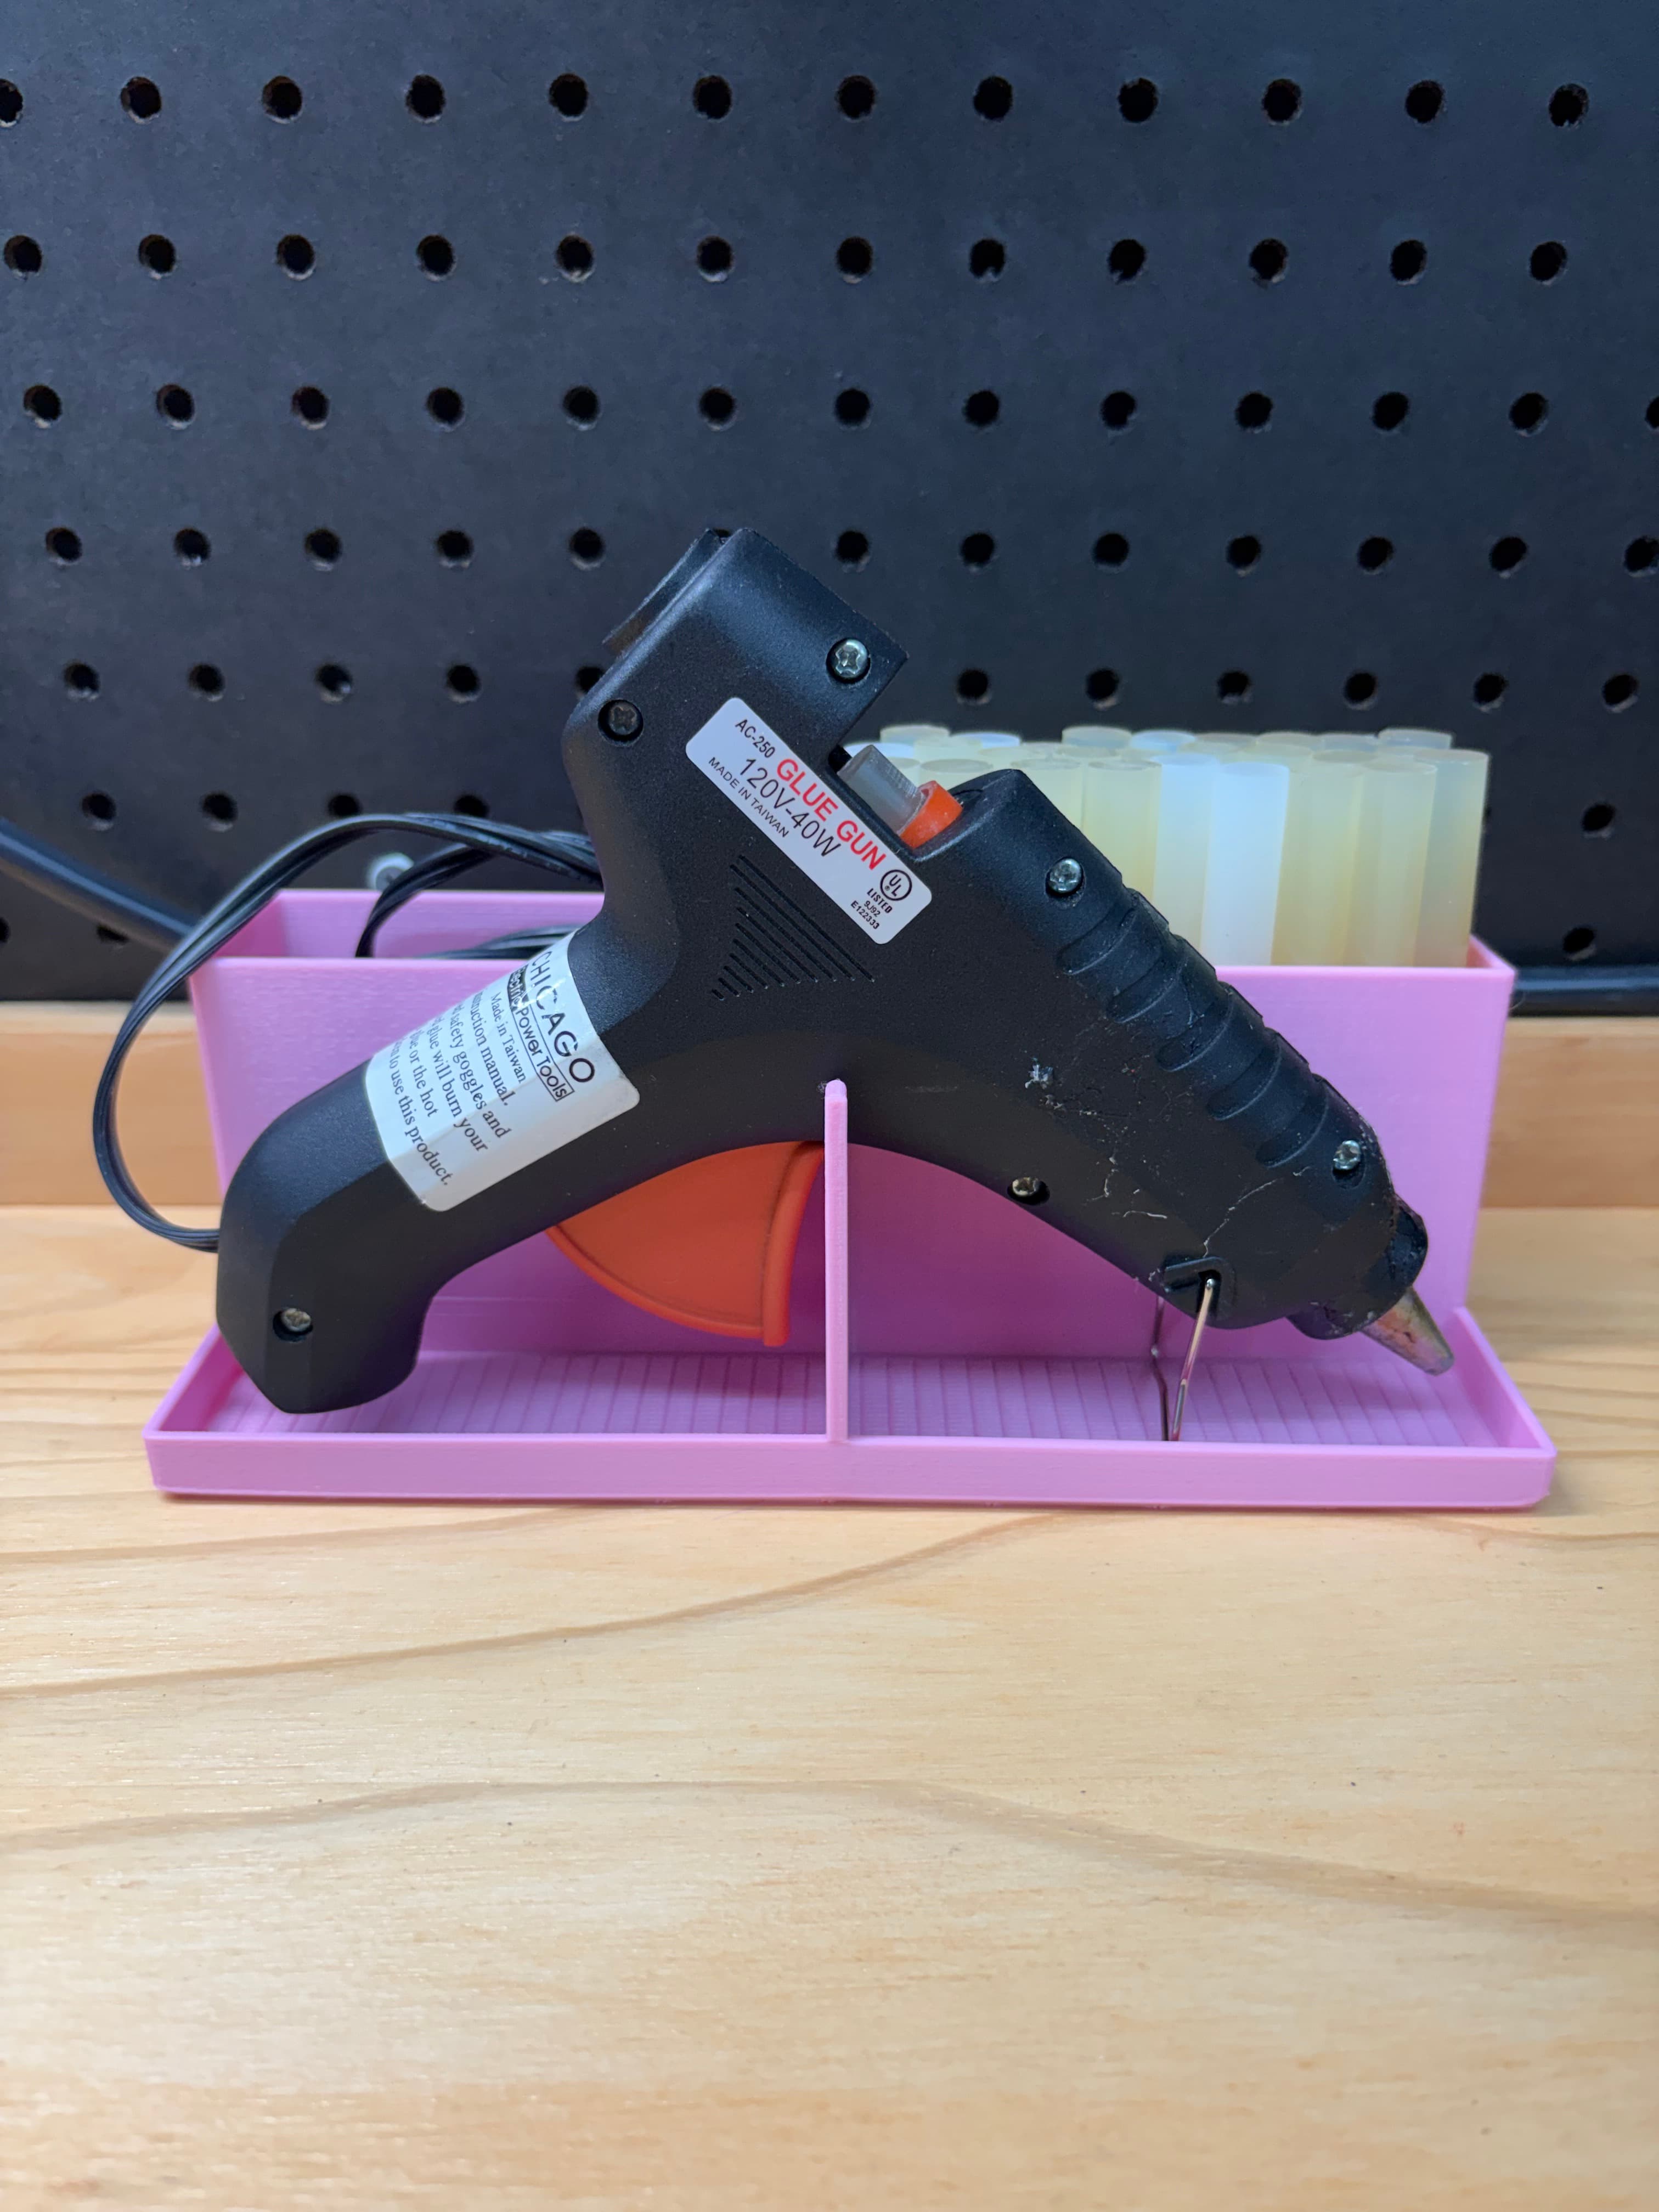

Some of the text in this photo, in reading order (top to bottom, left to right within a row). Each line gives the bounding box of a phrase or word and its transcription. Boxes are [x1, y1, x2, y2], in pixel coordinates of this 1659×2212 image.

[735, 719, 775, 758] AC-250
[708, 757, 789, 838] MADE IN TAIWAN
[740, 759, 841, 857] 120V-40W
[777, 759, 887, 870] GLUE GUN
[850, 901, 879, 929] E122333
[867, 888, 893, 913] LISTED
[450, 1013, 464, 1048] safety
[531, 951, 595, 1082] CHICAGO
[426, 1026, 443, 1049] glue
[491, 991, 526, 1084] Made in Taiwan
[515, 1006, 543, 1056] Power
[537, 1056, 567, 1098] Tools
[389, 1055, 400, 1069] to
[409, 1049, 420, 1064] or
[433, 1049, 453, 1080] will
[391, 1069, 404, 1095] use
[413, 1065, 427, 1089] the
[453, 1051, 487, 1110] goggles
[481, 1046, 516, 1106] manual.
[398, 1095, 417, 1125] this
[420, 1088, 439, 1118] hot
[442, 1077, 462, 1118] burn
[453, 1118, 488, 1152] your
[482, 1110, 512, 1138] and
[404, 1126, 453, 1186] product.
